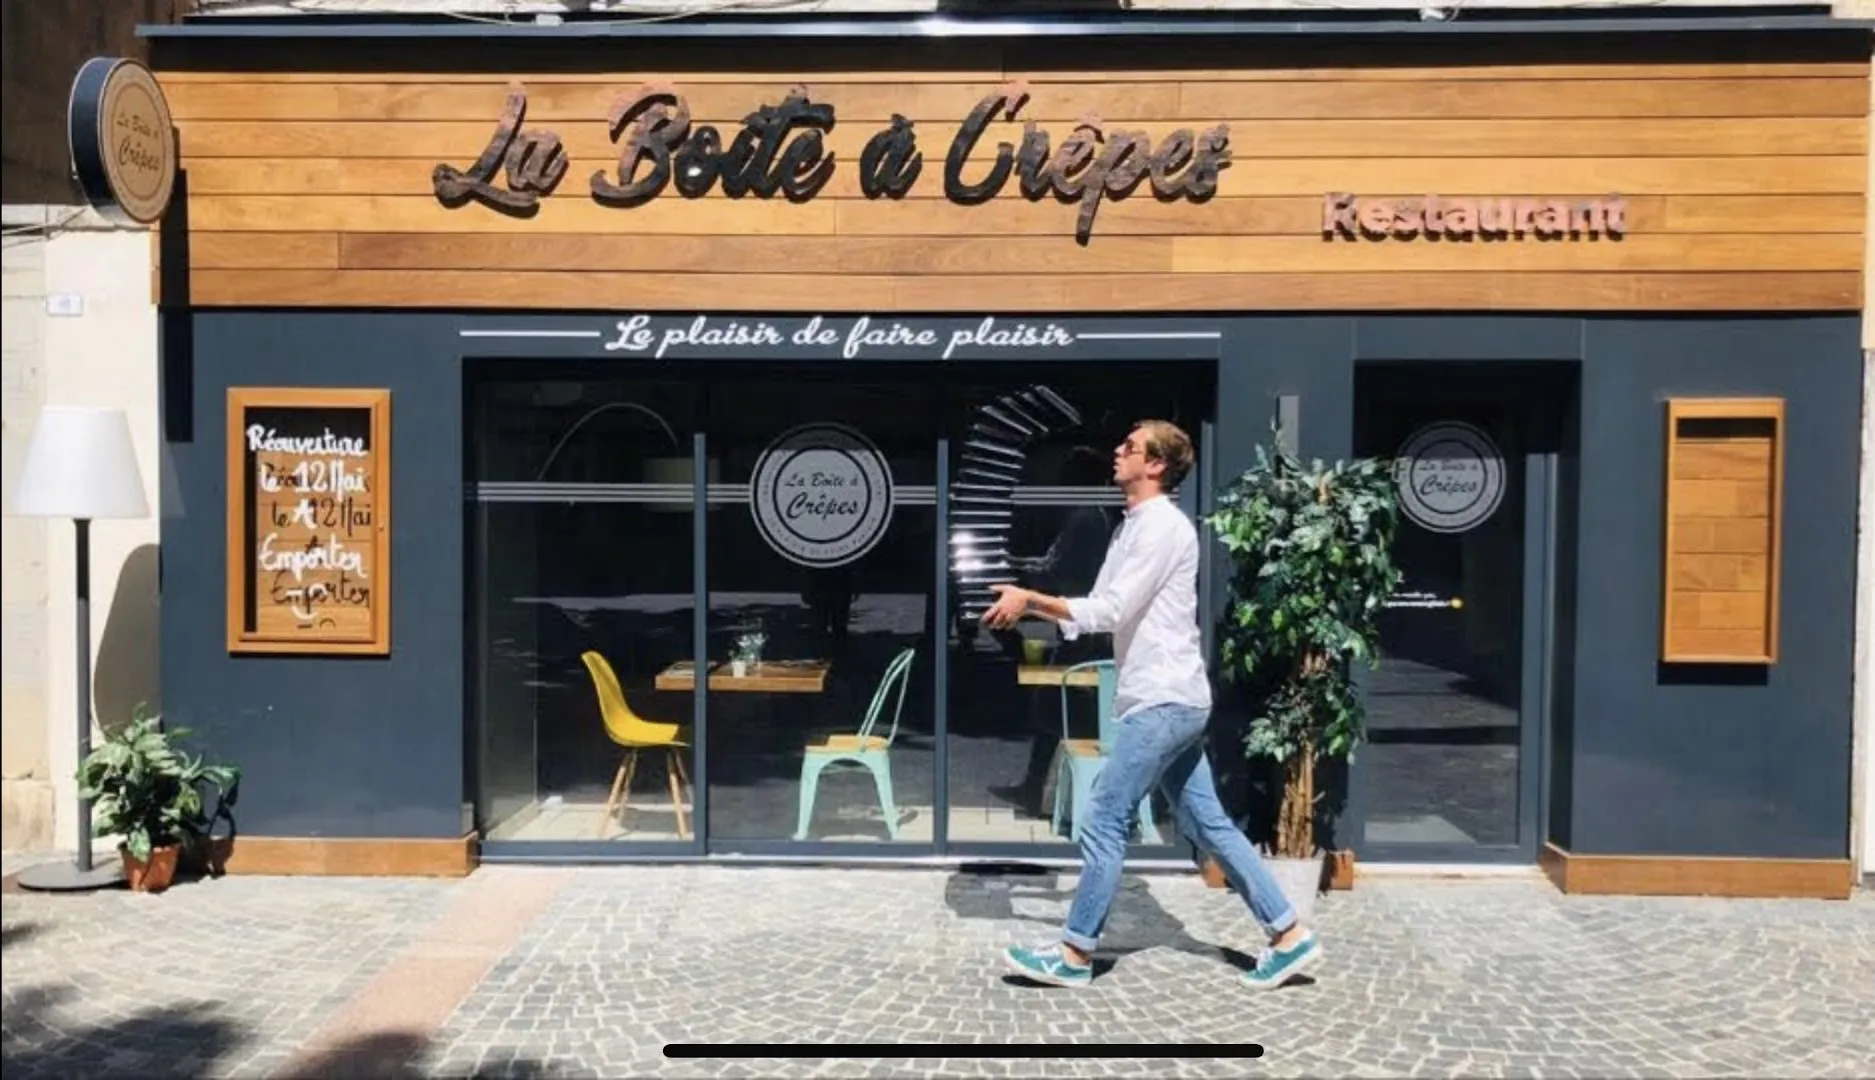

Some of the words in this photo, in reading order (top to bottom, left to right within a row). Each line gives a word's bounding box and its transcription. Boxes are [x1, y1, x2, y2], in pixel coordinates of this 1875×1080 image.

[432, 81, 569, 215] La
[860, 113, 923, 200] à
[944, 79, 1231, 245] Crêpes
[1321, 192, 1627, 239] Restaurant
[605, 315, 654, 350] Le
[655, 315, 783, 358] plaisir
[792, 315, 839, 344] de
[843, 316, 937, 359] faire
[942, 316, 1074, 359] plaisir
[246, 424, 369, 457] Réouverture
[260, 463, 281, 492] le
[292, 460, 329, 493] 12
[330, 459, 367, 502] Mai
[786, 491, 858, 520] Crêpes
[258, 532, 369, 581] Emporter
